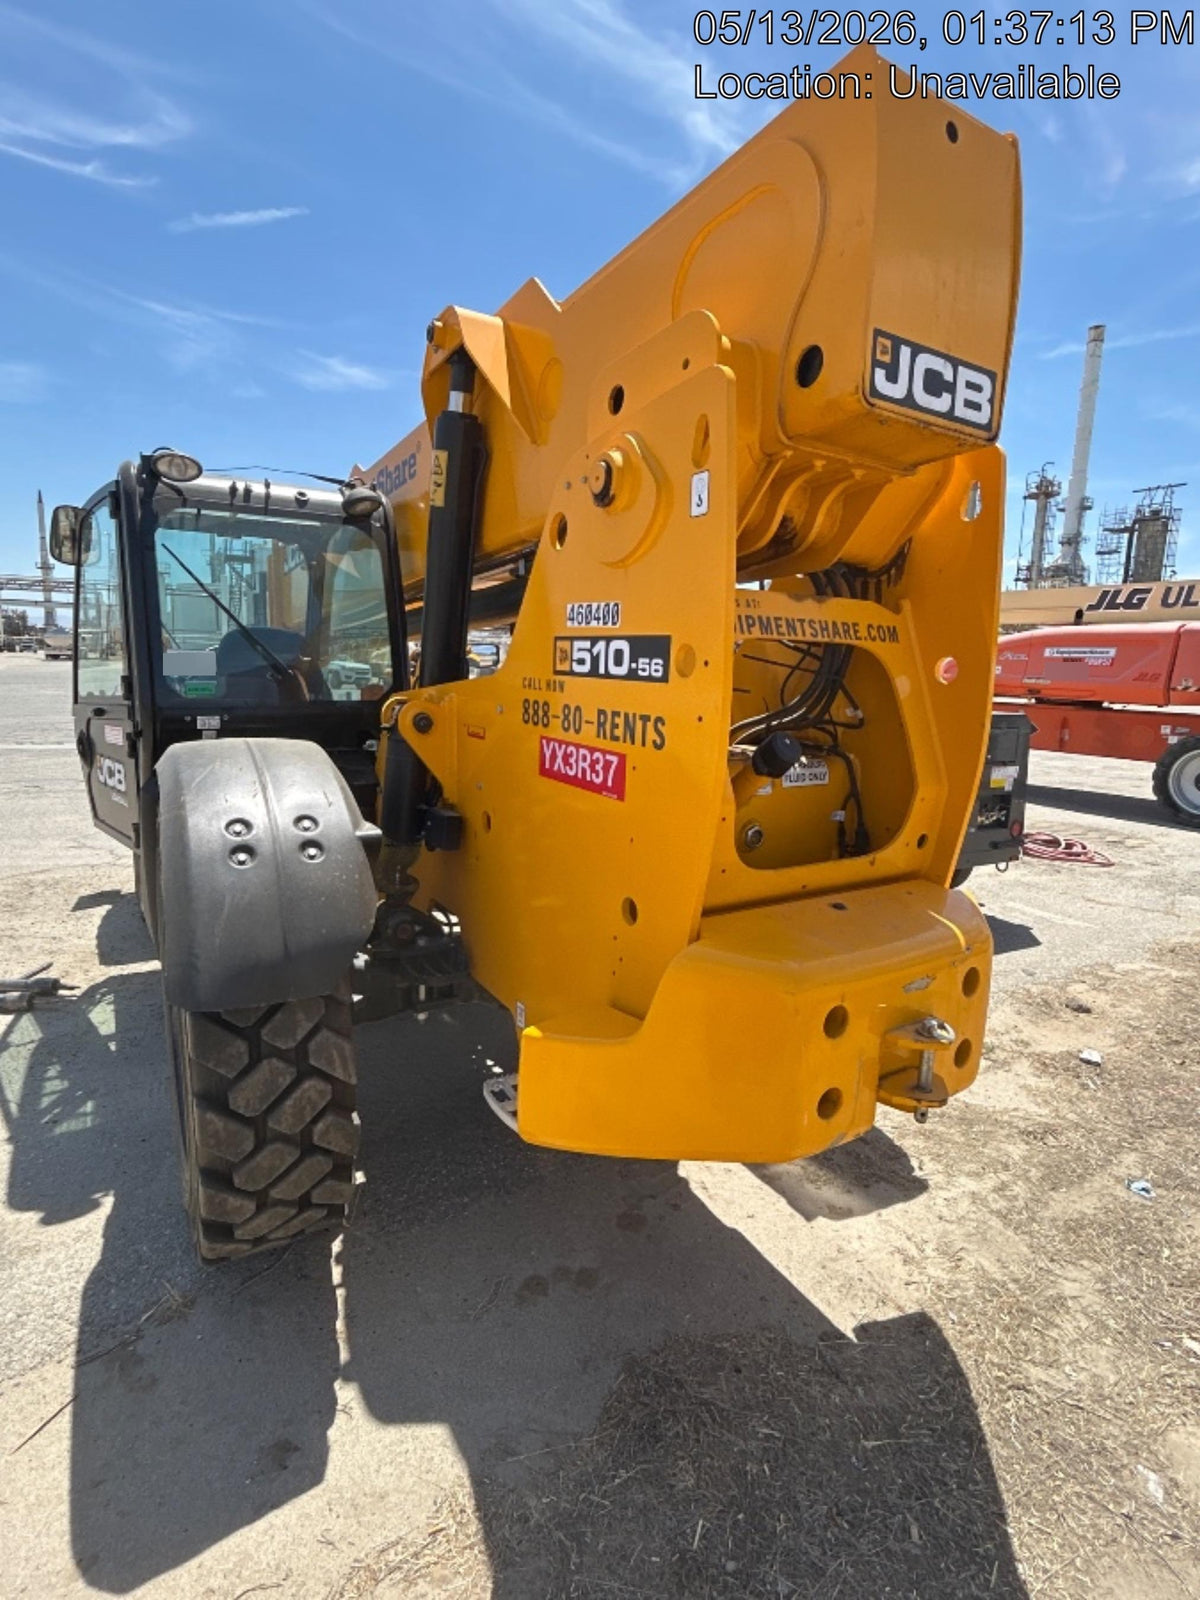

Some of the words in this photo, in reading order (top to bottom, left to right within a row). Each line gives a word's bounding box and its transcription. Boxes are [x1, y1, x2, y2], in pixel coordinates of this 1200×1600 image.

[874, 344, 992, 425] JCB
[567, 602, 620, 627] 460400
[1085, 588, 1153, 612] JLG
[734, 614, 899, 644] IPMENTSHARE.COM
[572, 639, 664, 678] 510-56
[522, 677, 543, 691] CALL
[522, 698, 666, 751] 888-80-RENTS
[97, 756, 126, 792] JCB
[541, 738, 619, 787] YX3R37
